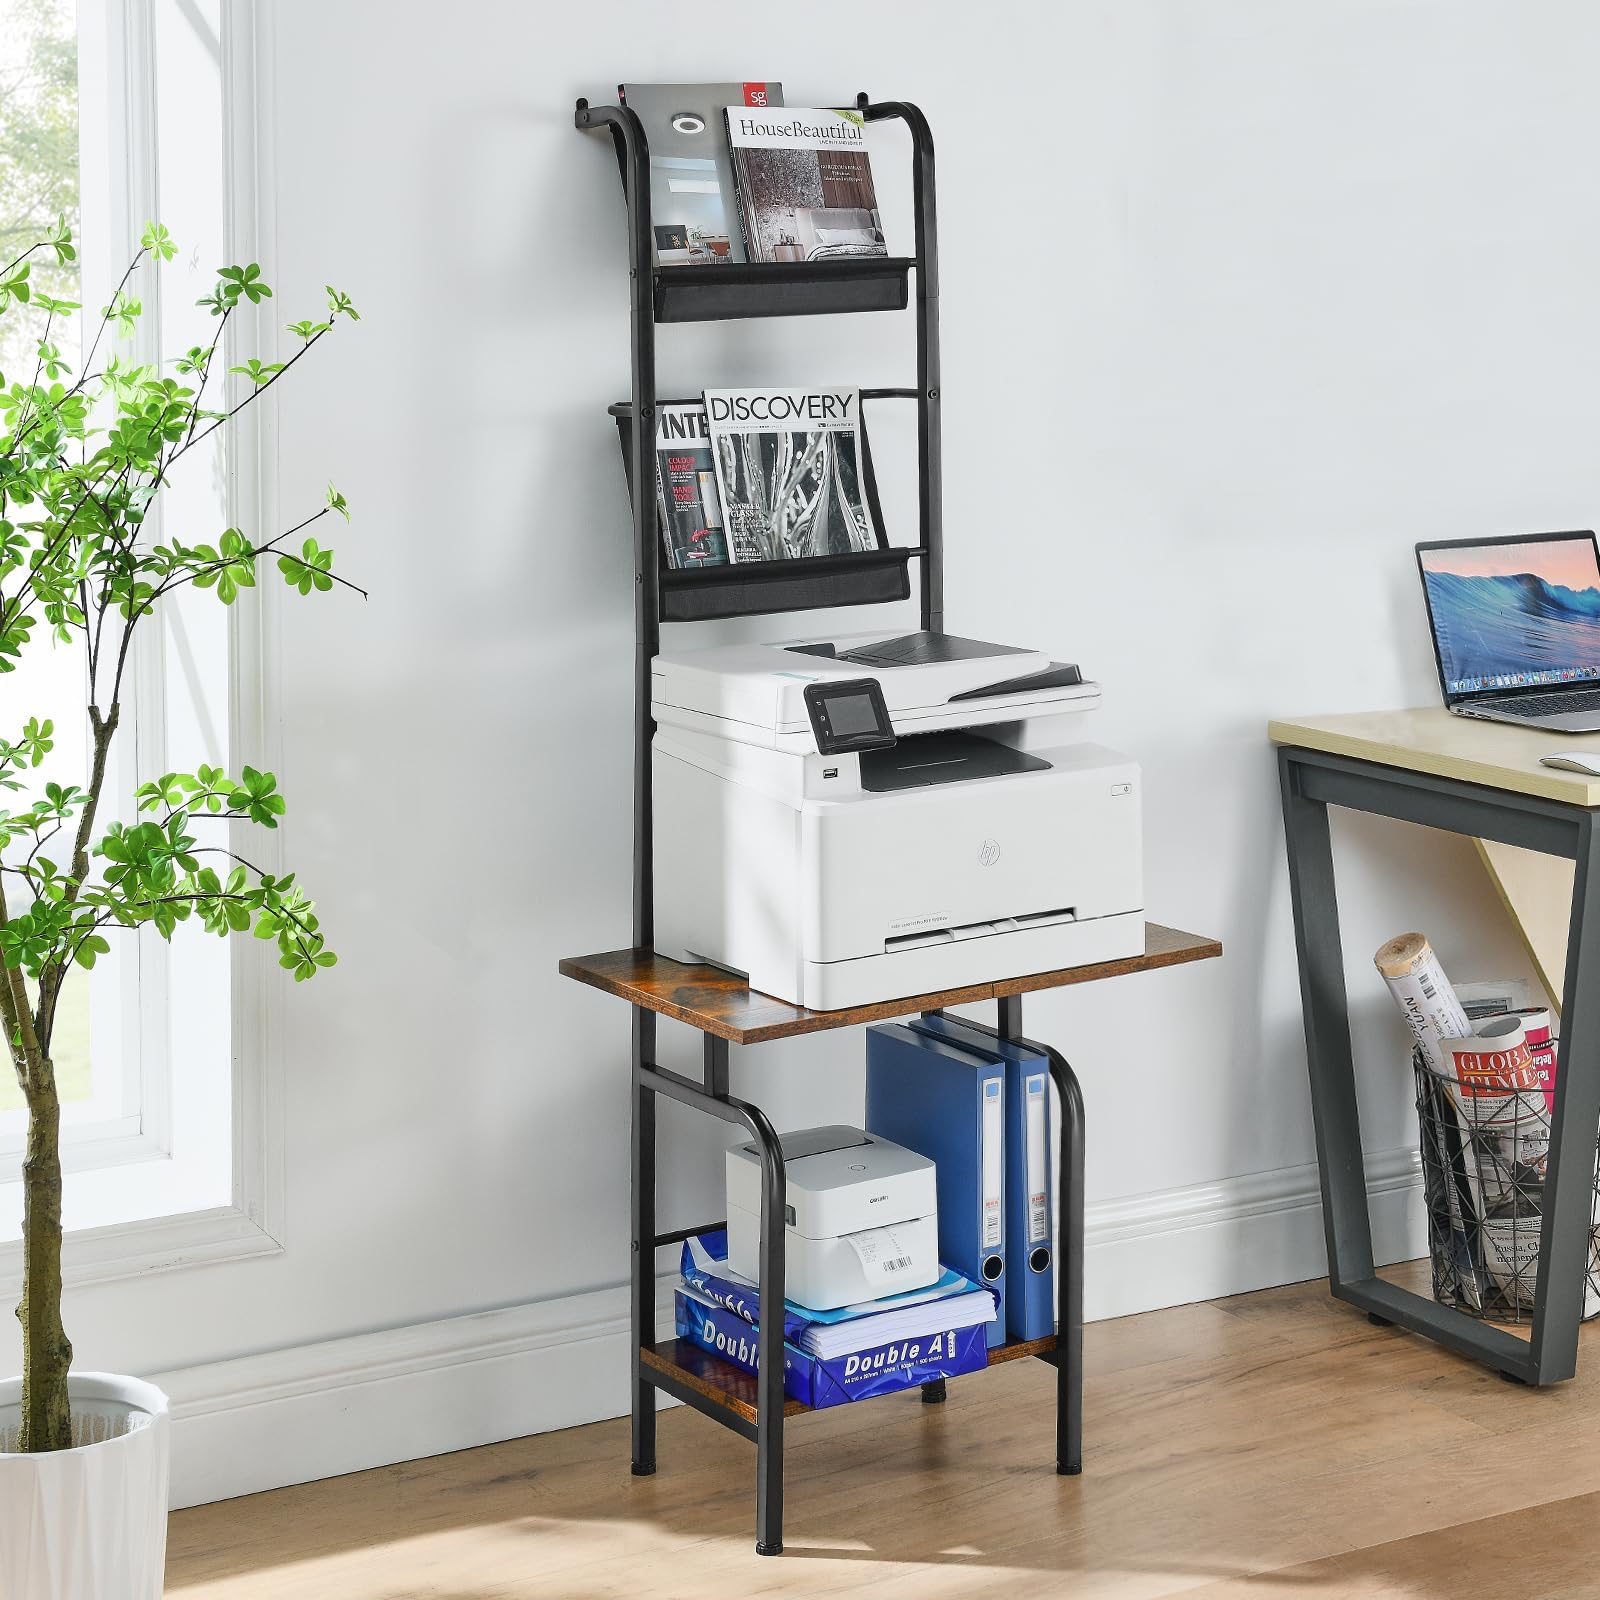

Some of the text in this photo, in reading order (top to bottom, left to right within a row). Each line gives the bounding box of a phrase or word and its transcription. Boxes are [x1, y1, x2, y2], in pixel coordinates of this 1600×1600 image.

[750, 91, 768, 106] sg
[711, 394, 853, 421] DISCOVERY
[1404, 996, 1429, 1032] YUAN
[703, 1319, 760, 1370] Doubl
[844, 1334, 942, 1377] Double A
